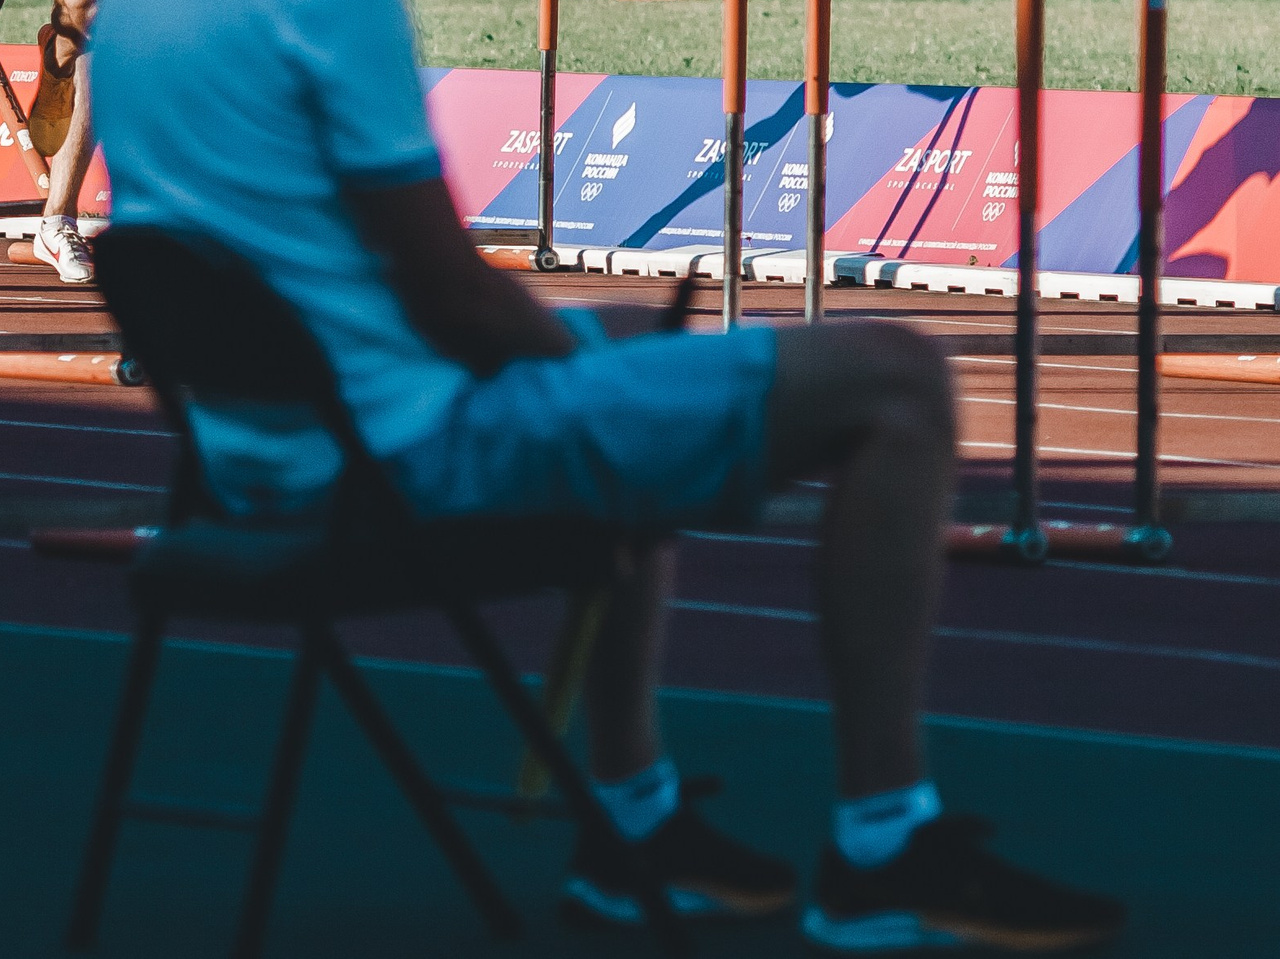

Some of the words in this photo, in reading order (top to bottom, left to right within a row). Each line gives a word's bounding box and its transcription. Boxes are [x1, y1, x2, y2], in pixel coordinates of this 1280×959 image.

[500, 129, 574, 156] ZASPRT
[583, 152, 629, 167] КОМАНДА
[694, 138, 769, 166] ZASORT
[492, 160, 539, 171] SPORT&CAS
[894, 147, 973, 174] ZASPORT
[581, 166, 620, 180] РОССИИ
[781, 163, 808, 176] КОМА
[985, 171, 1018, 186] КОМАН
